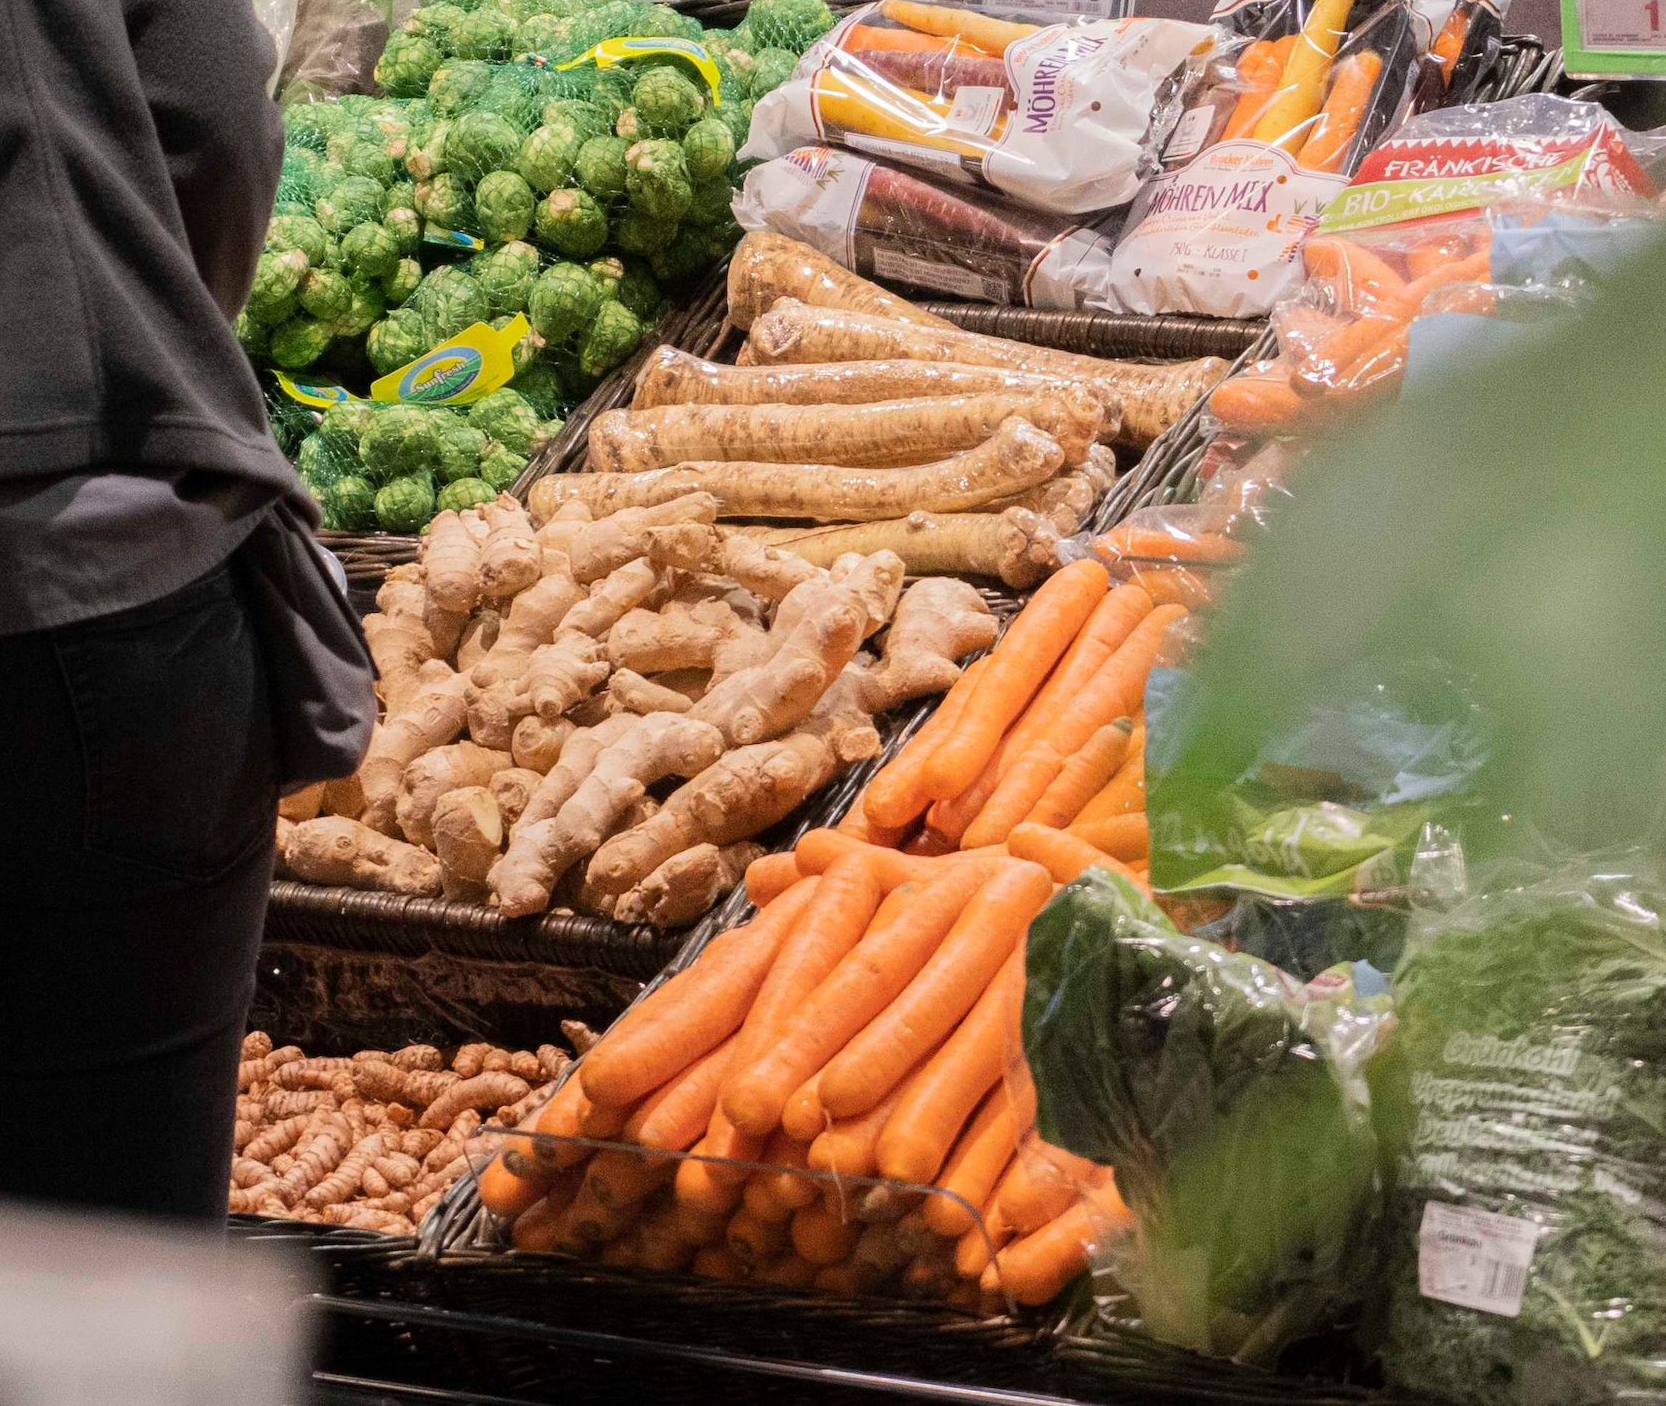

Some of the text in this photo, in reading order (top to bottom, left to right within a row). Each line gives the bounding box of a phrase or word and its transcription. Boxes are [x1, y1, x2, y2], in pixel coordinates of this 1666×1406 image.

[1022, 41, 1070, 134] MÖHREN
[1384, 151, 1566, 178] FRÄNKISCHE
[1146, 177, 1274, 218] MÖHREN MIX
[1203, 244, 1240, 262] KLASSE
[415, 361, 466, 392] Sunfresh
[1443, 1031, 1582, 1076] Grünkohl
